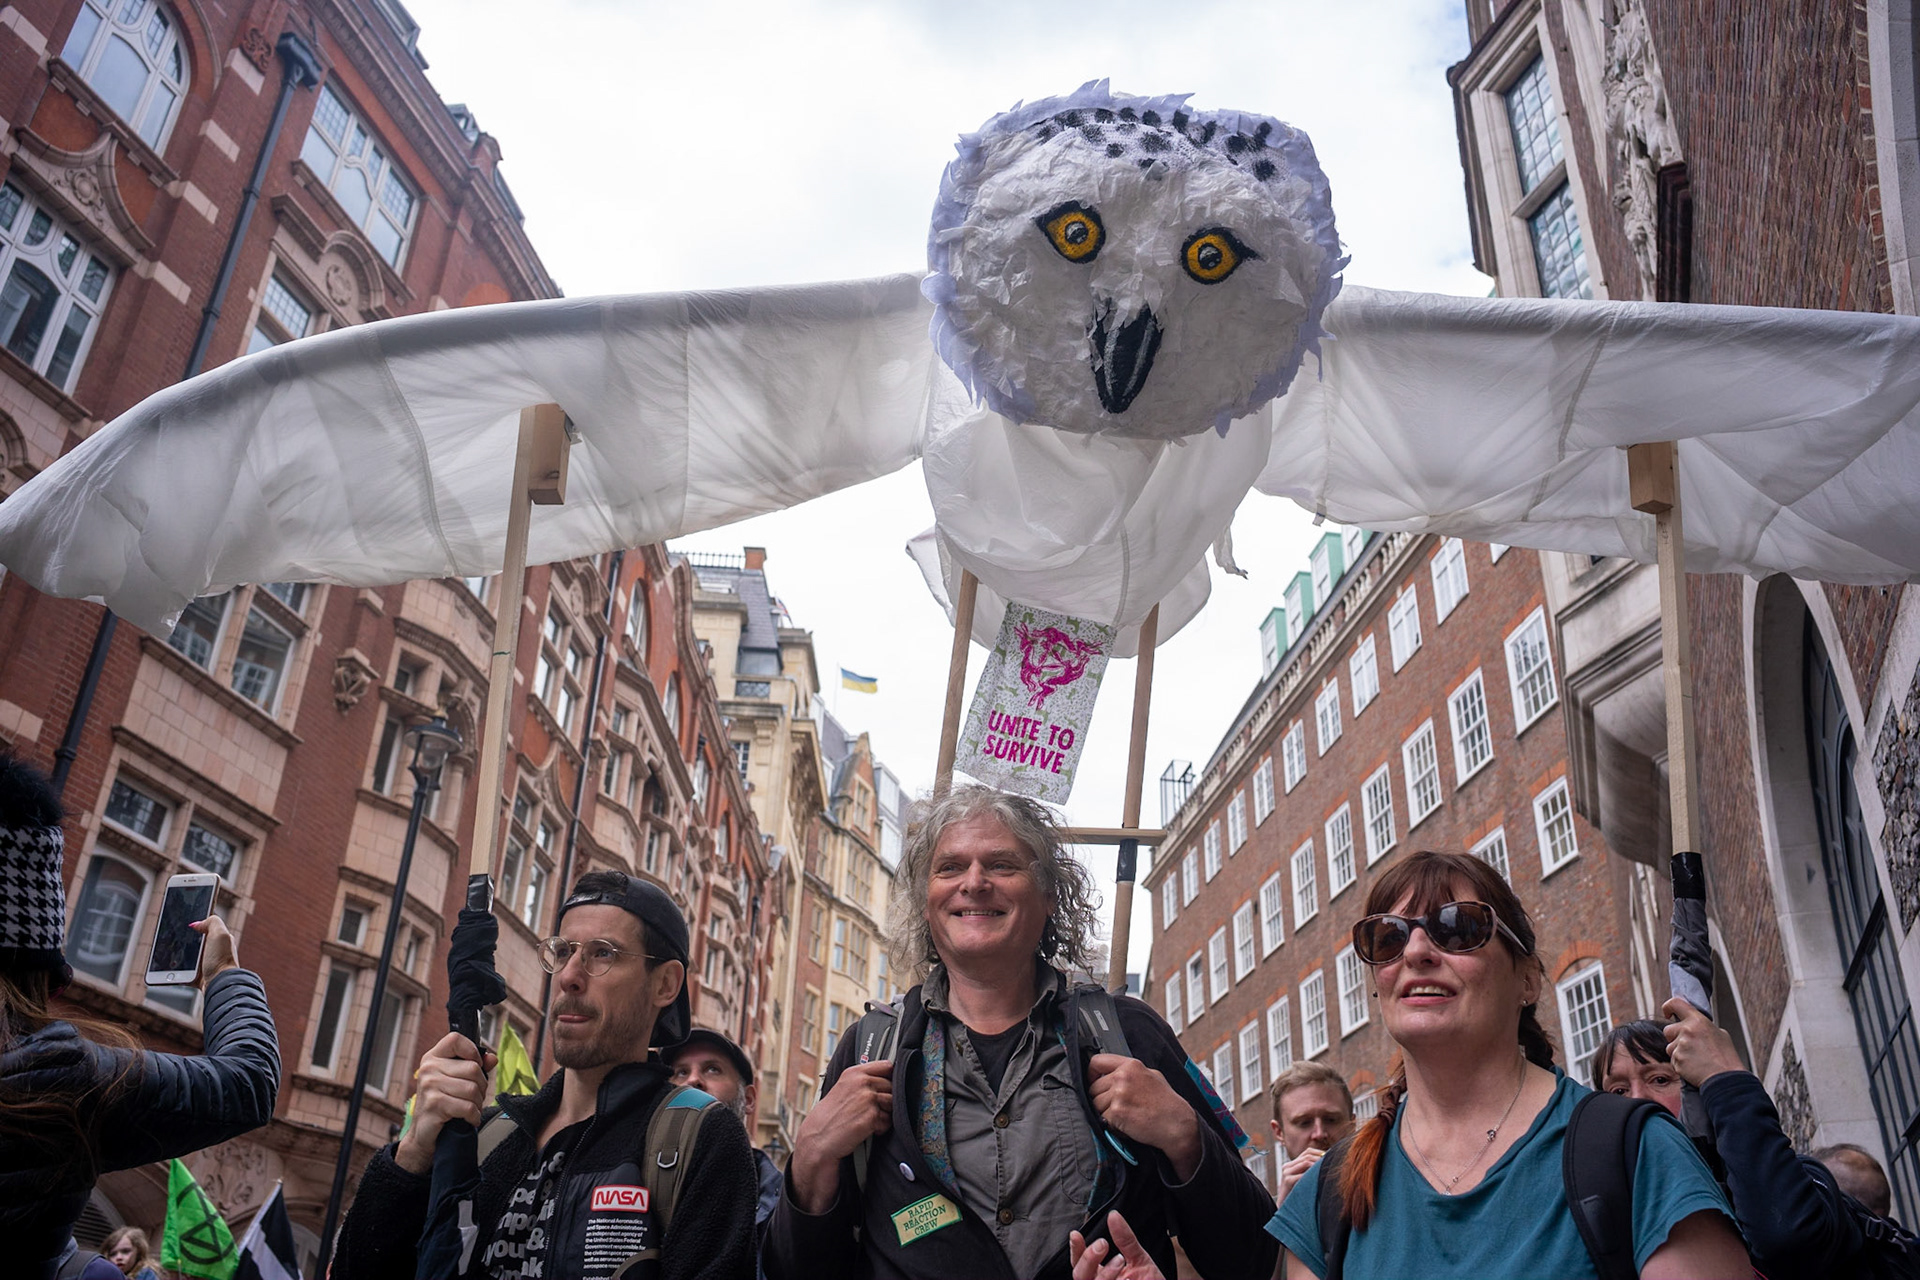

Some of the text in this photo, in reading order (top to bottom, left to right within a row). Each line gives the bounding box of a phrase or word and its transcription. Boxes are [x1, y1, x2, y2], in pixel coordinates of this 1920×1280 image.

[988, 709, 1075, 750] UNITE TO
[983, 734, 1065, 774] SURVIVE
[595, 1190, 645, 1207] NASA
[907, 1200, 934, 1218] RAPID
[903, 1204, 946, 1231] REACTION
[914, 1217, 938, 1235] CREW
